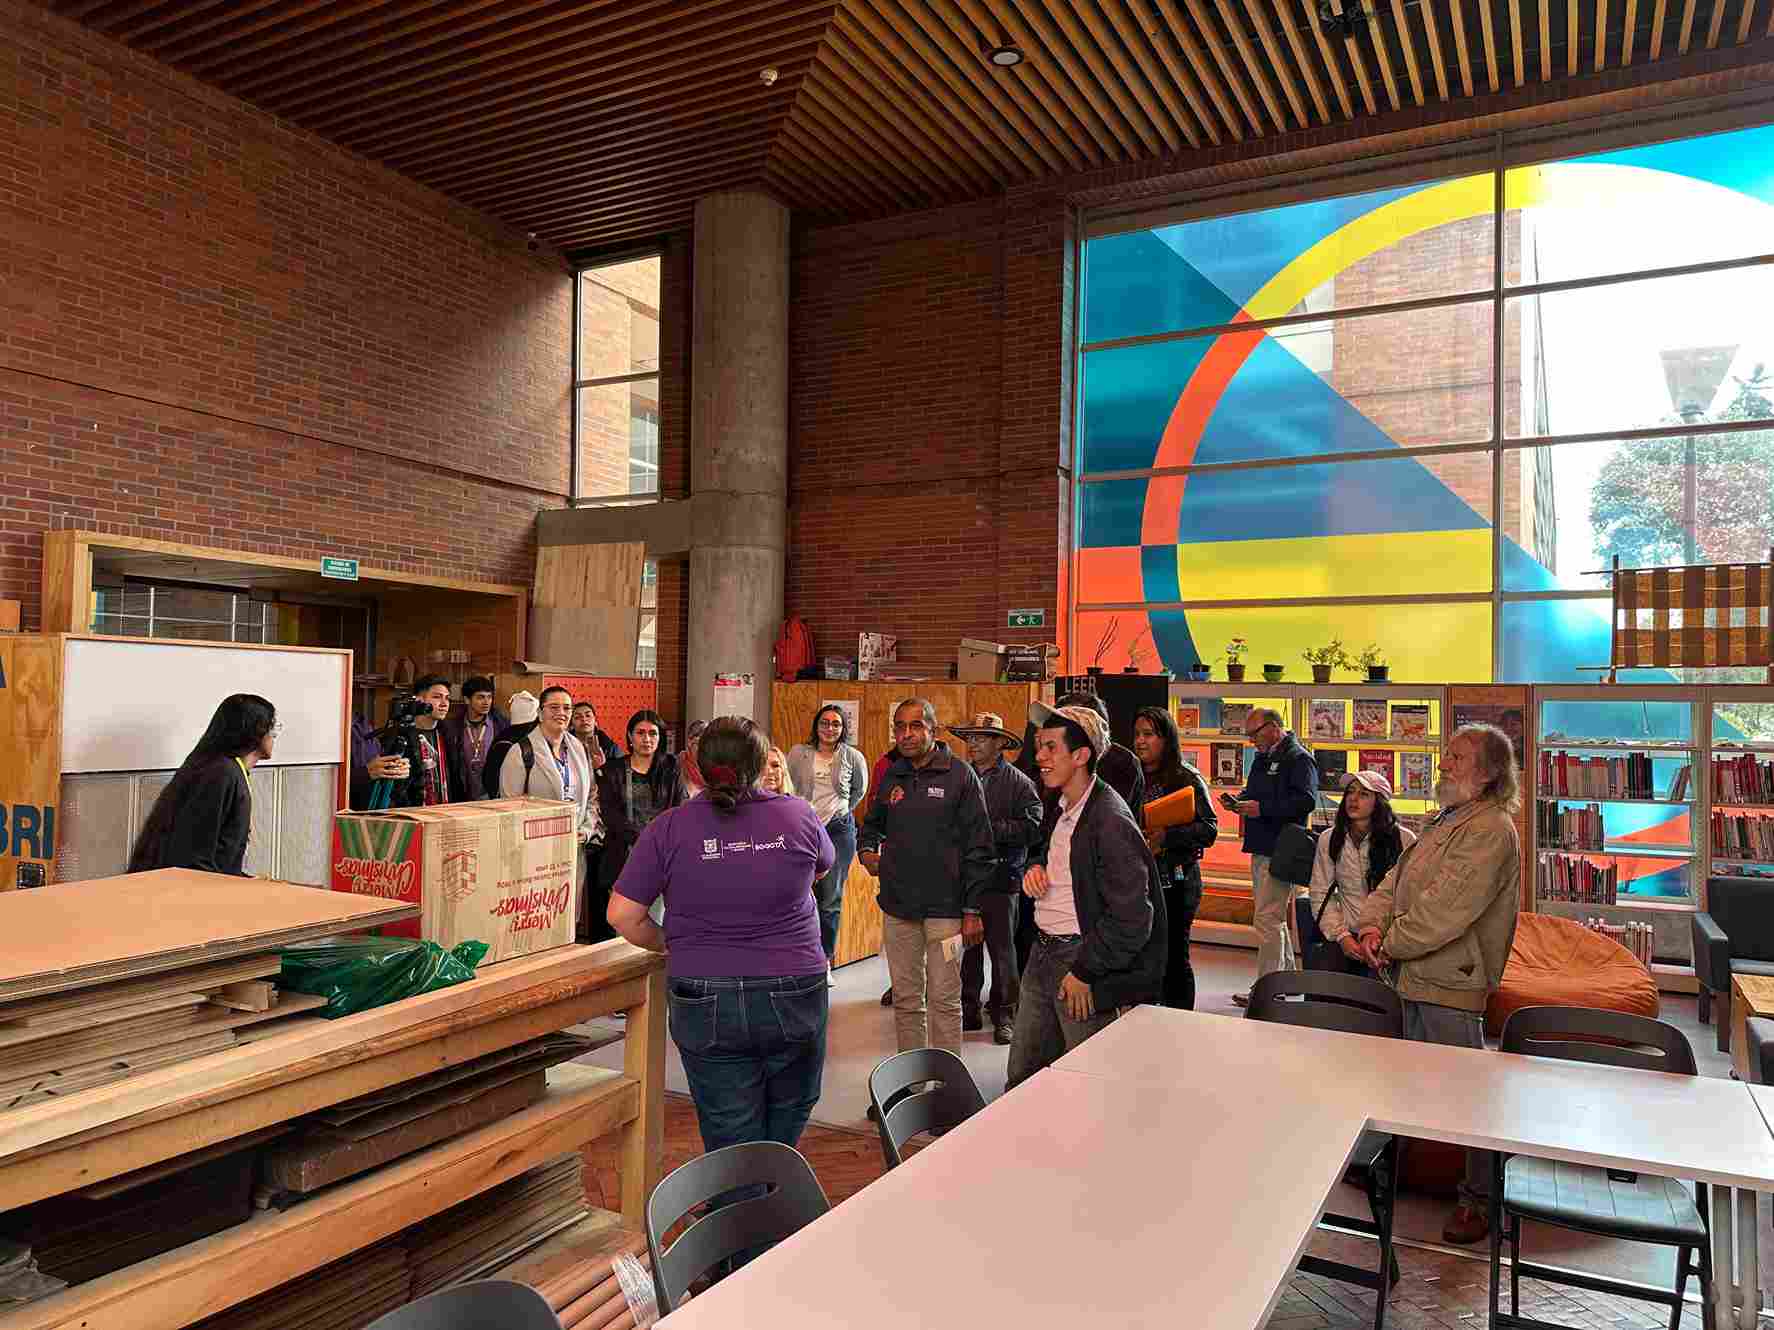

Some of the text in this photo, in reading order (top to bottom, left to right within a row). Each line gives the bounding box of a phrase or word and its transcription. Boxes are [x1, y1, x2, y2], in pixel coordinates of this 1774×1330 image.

[1065, 676, 1097, 695] LEER
[489, 881, 570, 920] Christmas
[509, 911, 553, 933] Merry
